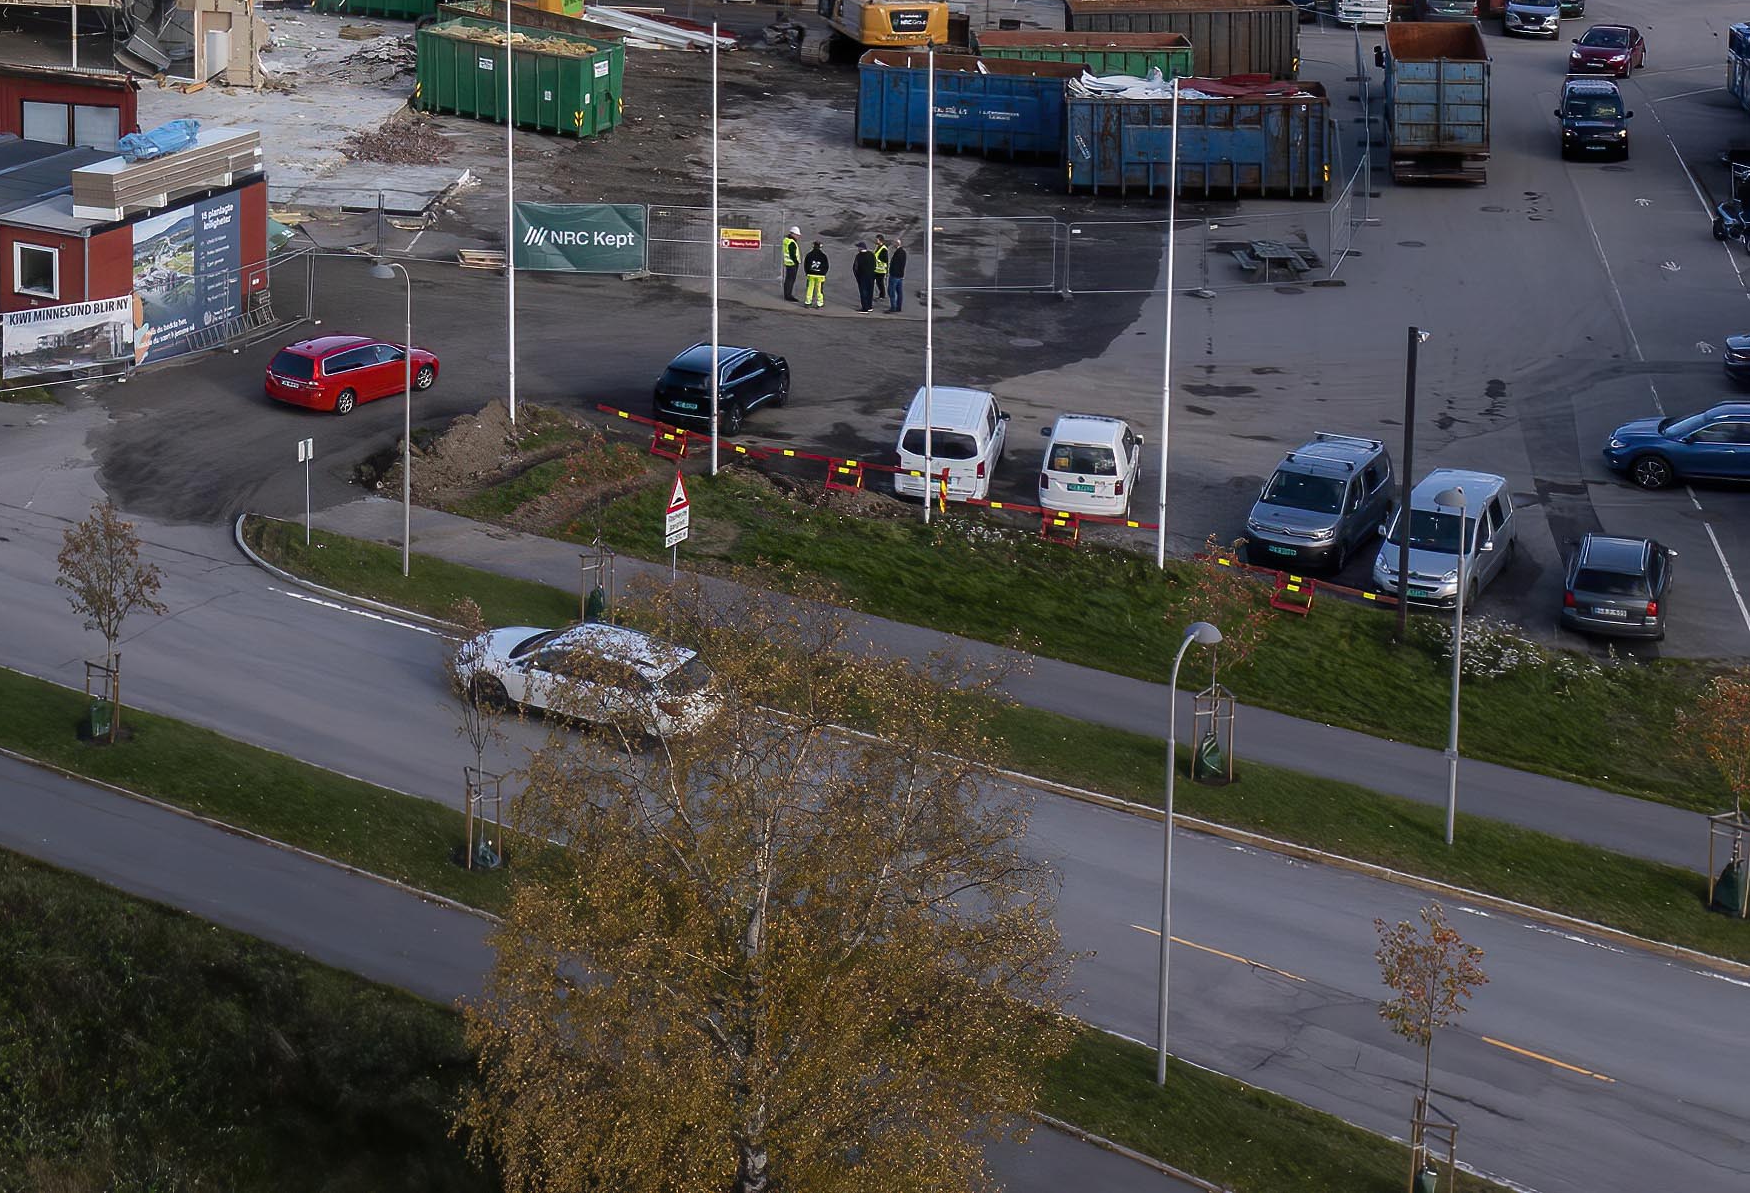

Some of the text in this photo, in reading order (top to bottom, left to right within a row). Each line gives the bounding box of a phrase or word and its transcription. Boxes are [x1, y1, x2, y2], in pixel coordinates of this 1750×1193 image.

[550, 230, 635, 249] NRC Kept
[10, 298, 129, 326] KIWI MINNESUND BLIR NY
